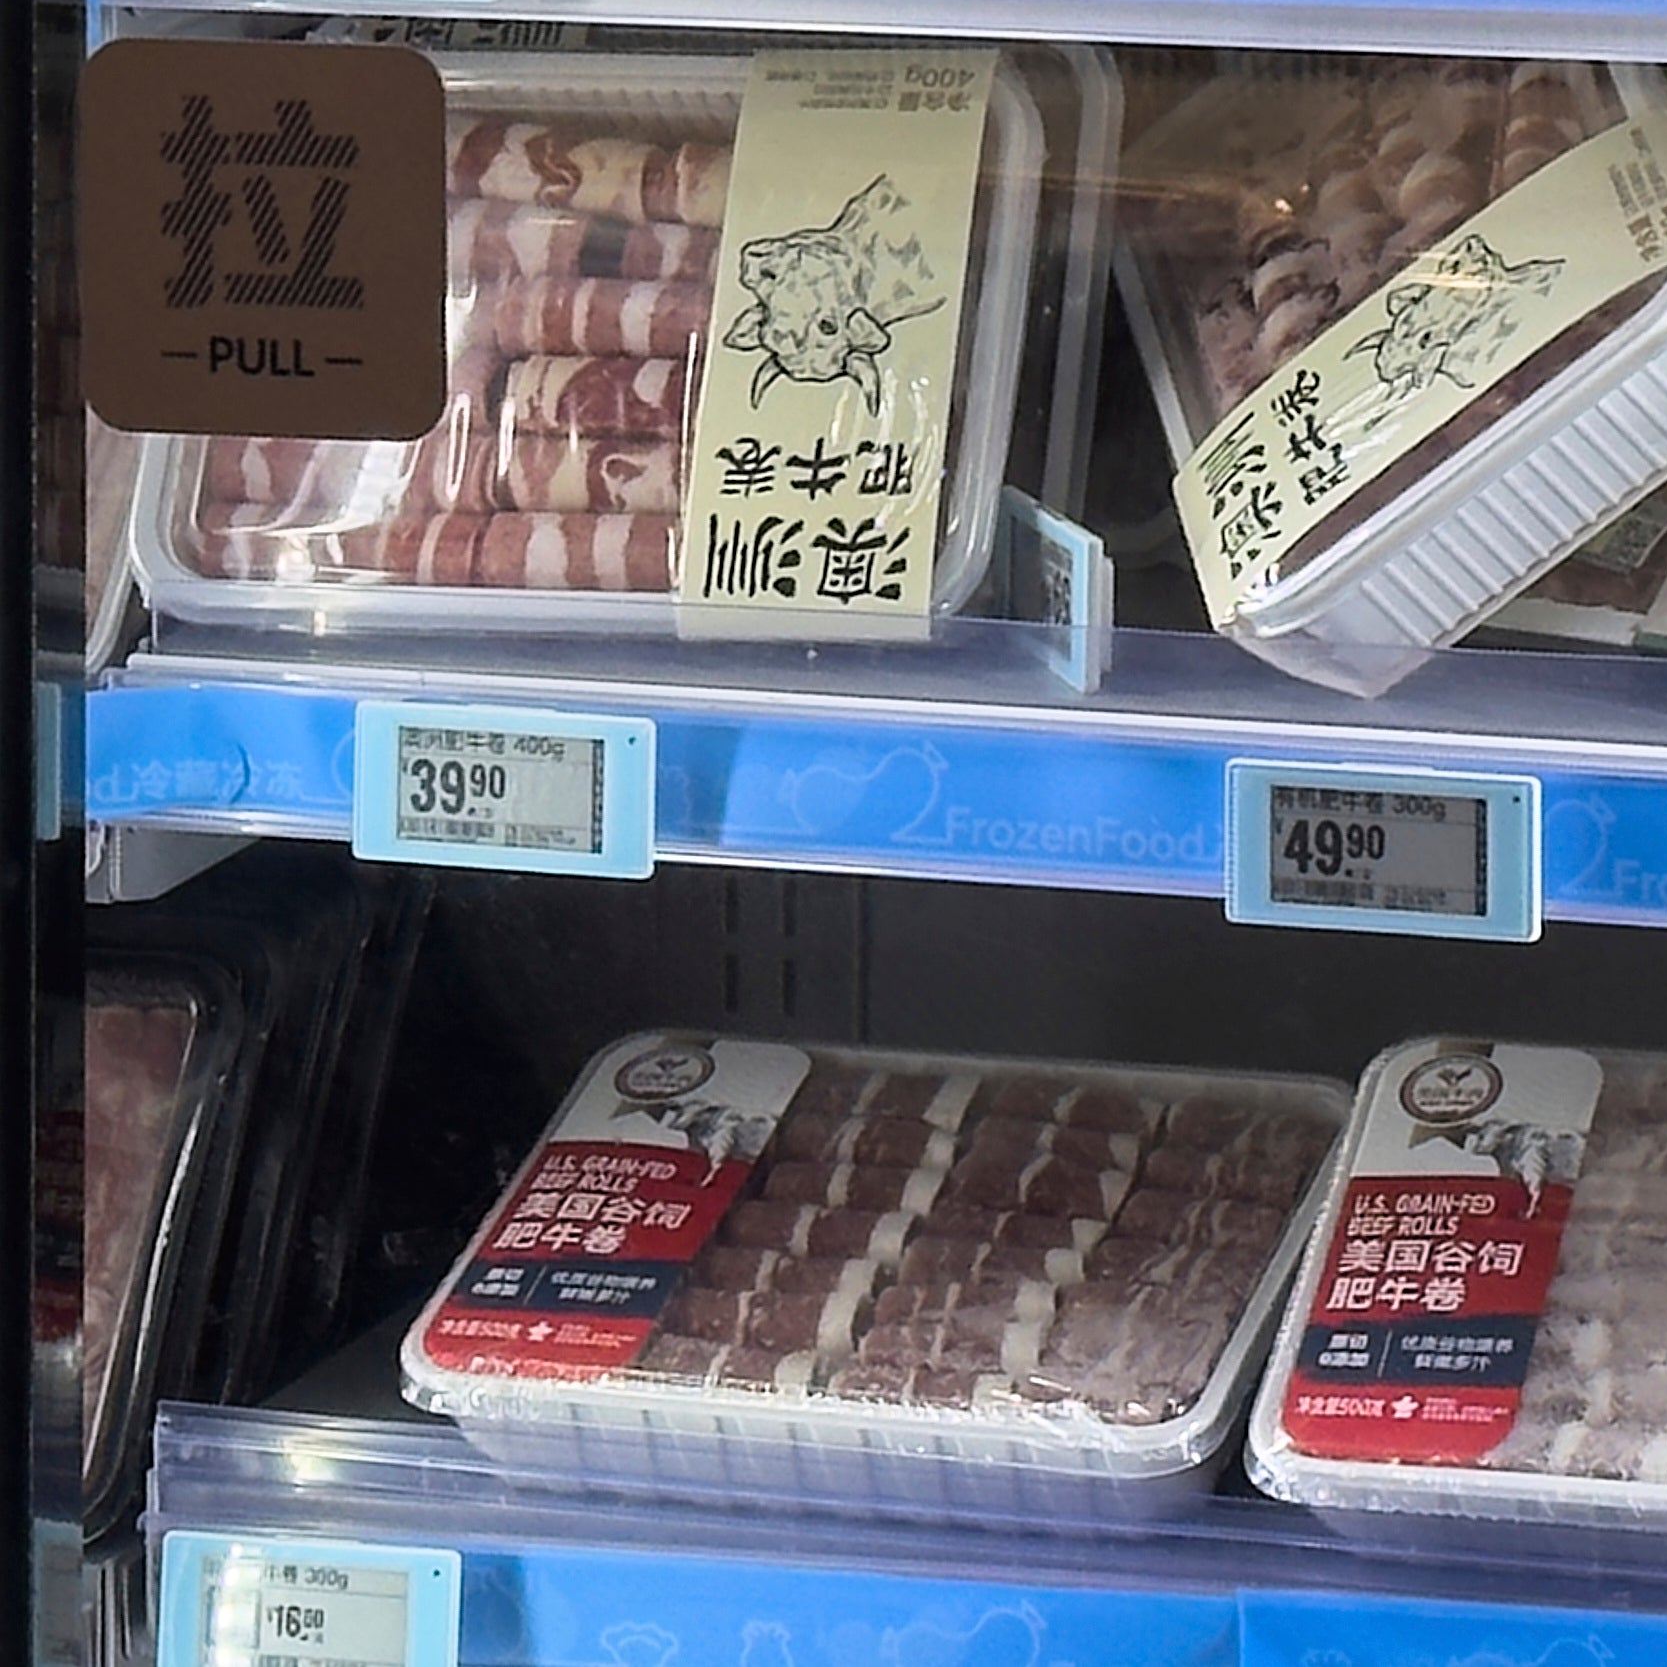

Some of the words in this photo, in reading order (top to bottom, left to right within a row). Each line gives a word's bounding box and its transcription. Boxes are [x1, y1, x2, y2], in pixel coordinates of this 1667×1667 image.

[160, 94, 365, 310] 拉
[208, 336, 316, 378] PULL
[703, 513, 910, 603] 澳洲
[512, 1193, 692, 1230] 美国谷饲
[1398, 1216, 1460, 1236] ROLLS
[493, 1222, 627, 1256] 肥牛卷
[1338, 1239, 1525, 1277] 美国谷饲
[1326, 1276, 1468, 1312] 肥牛卷
